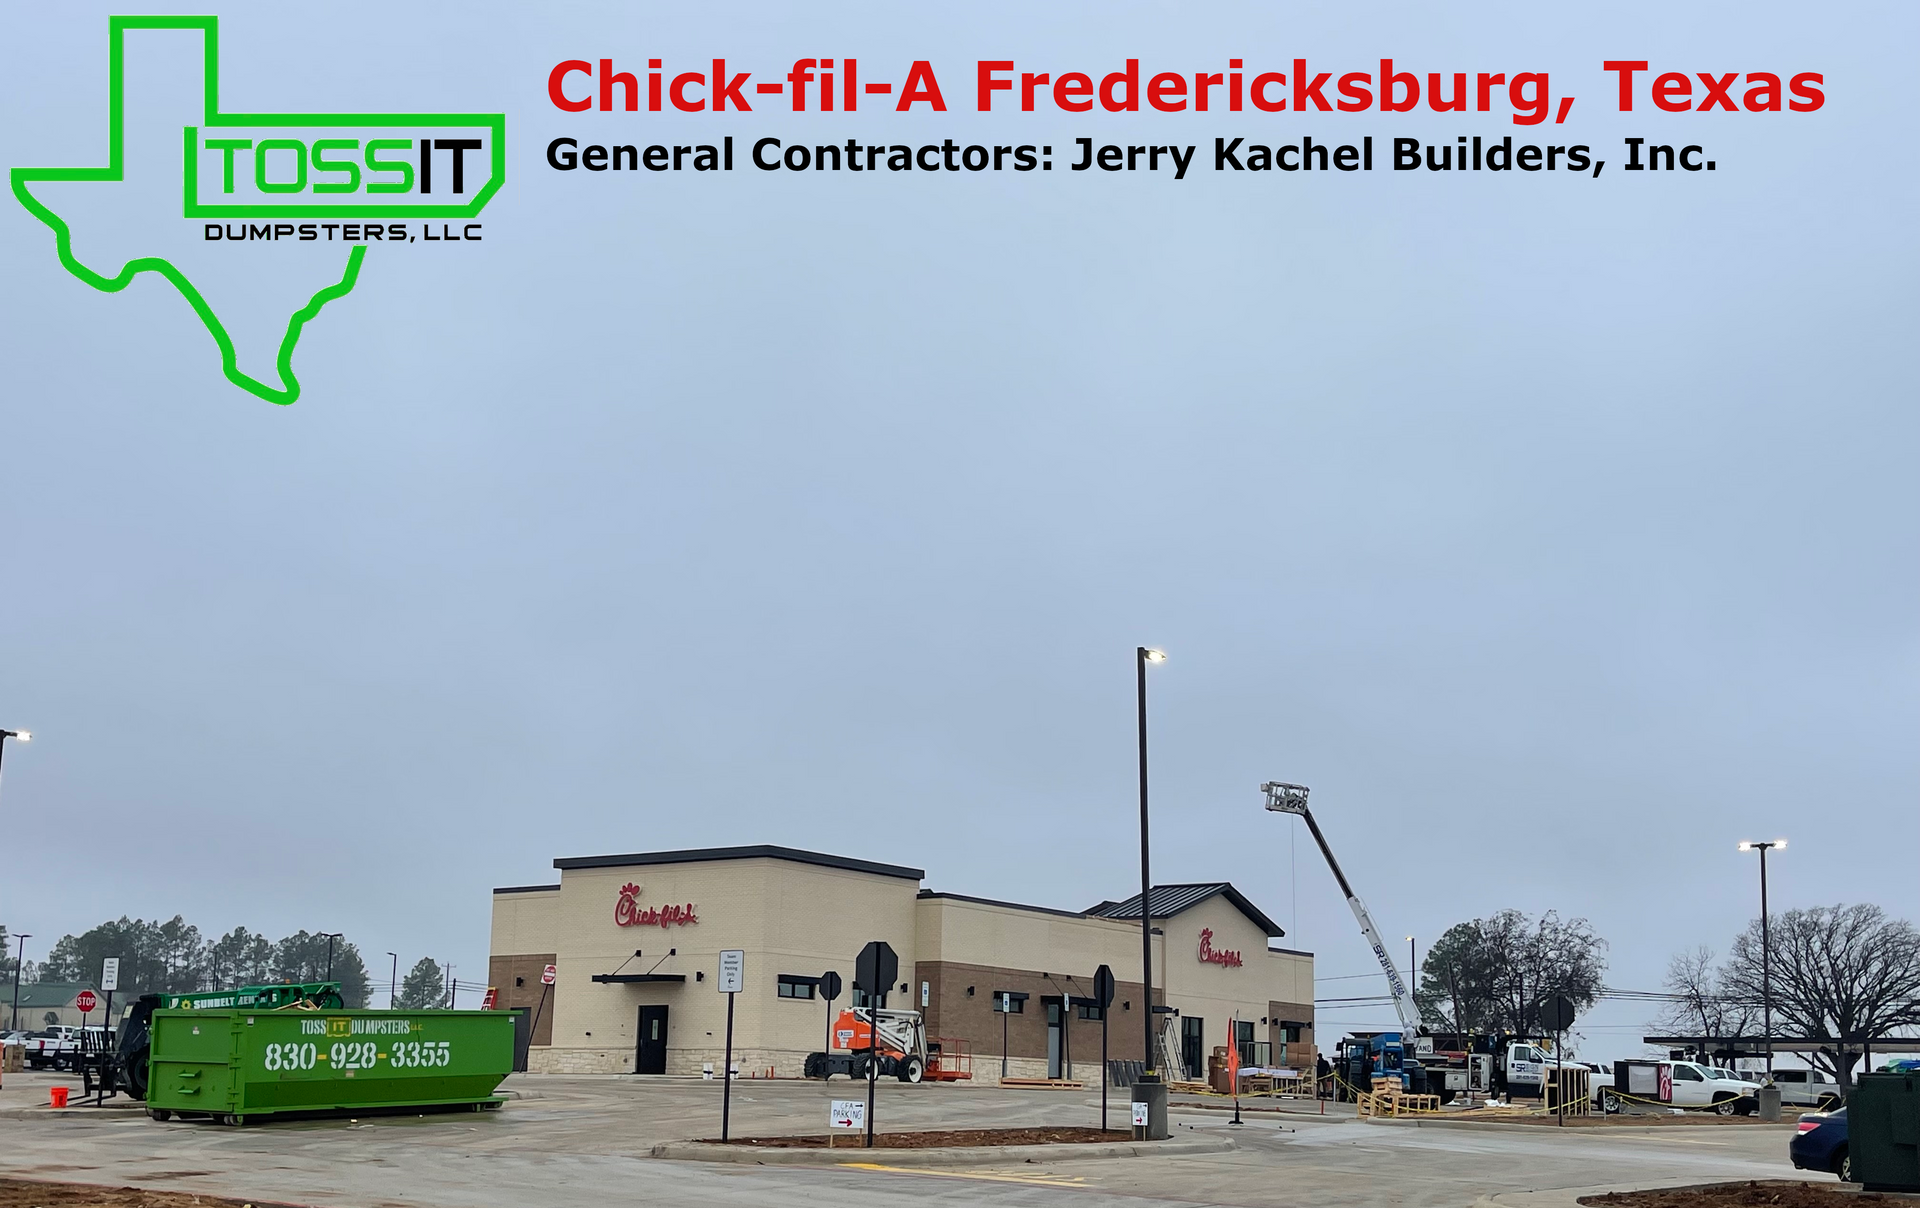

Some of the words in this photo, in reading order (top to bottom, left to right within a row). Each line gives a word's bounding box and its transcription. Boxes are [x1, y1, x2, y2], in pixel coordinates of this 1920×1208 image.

[615, 883, 696, 928] Chick-fil-A
[77, 997, 96, 1006] STOP
[194, 997, 236, 1010] SUNBELT
[301, 1019, 327, 1035] TOSS
[333, 1021, 347, 1032] IT
[351, 1019, 411, 1035] DUMPSTERS
[264, 1041, 450, 1071] 830-928-3355
[833, 1109, 862, 1120] PARKING
